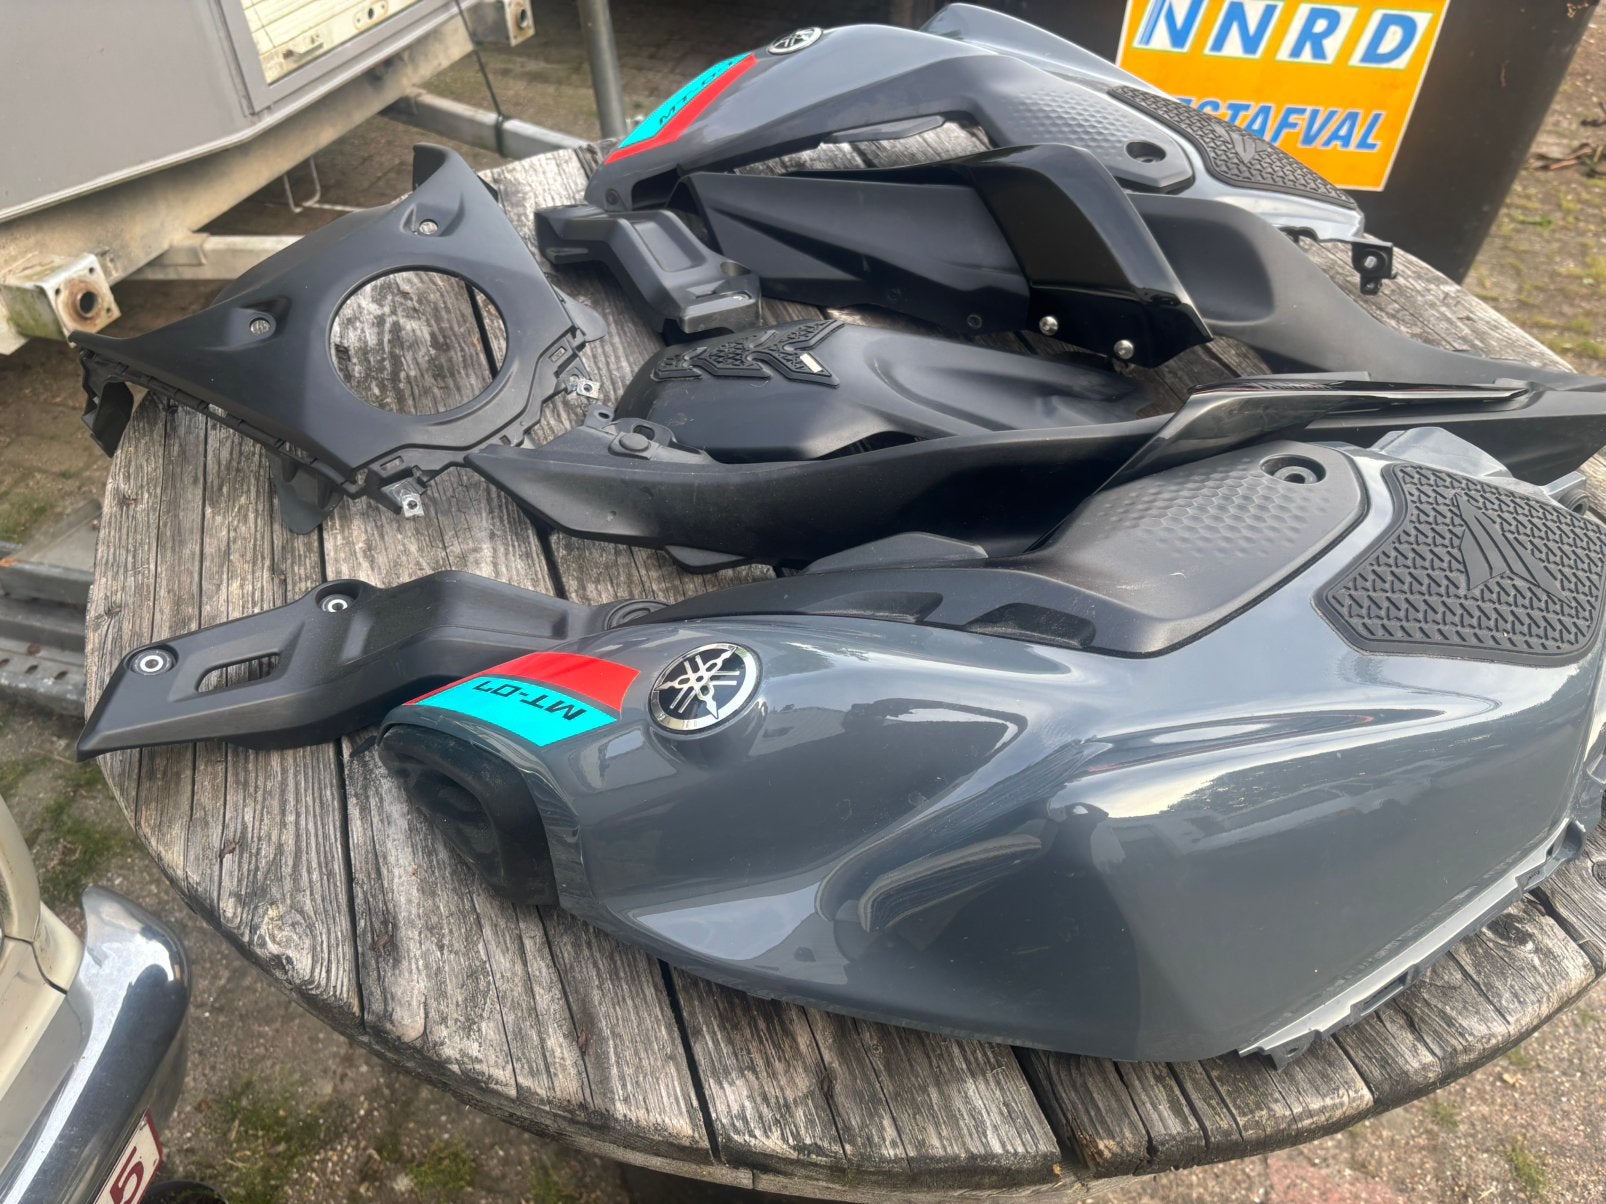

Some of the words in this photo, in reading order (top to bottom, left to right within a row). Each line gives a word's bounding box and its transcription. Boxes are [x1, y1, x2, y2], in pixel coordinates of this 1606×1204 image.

[1138, 0, 1418, 66] NNRD
[1177, 98, 1384, 151] TAFVAL
[472, 680, 587, 721] MT-07
[109, 1145, 145, 1204] 5
